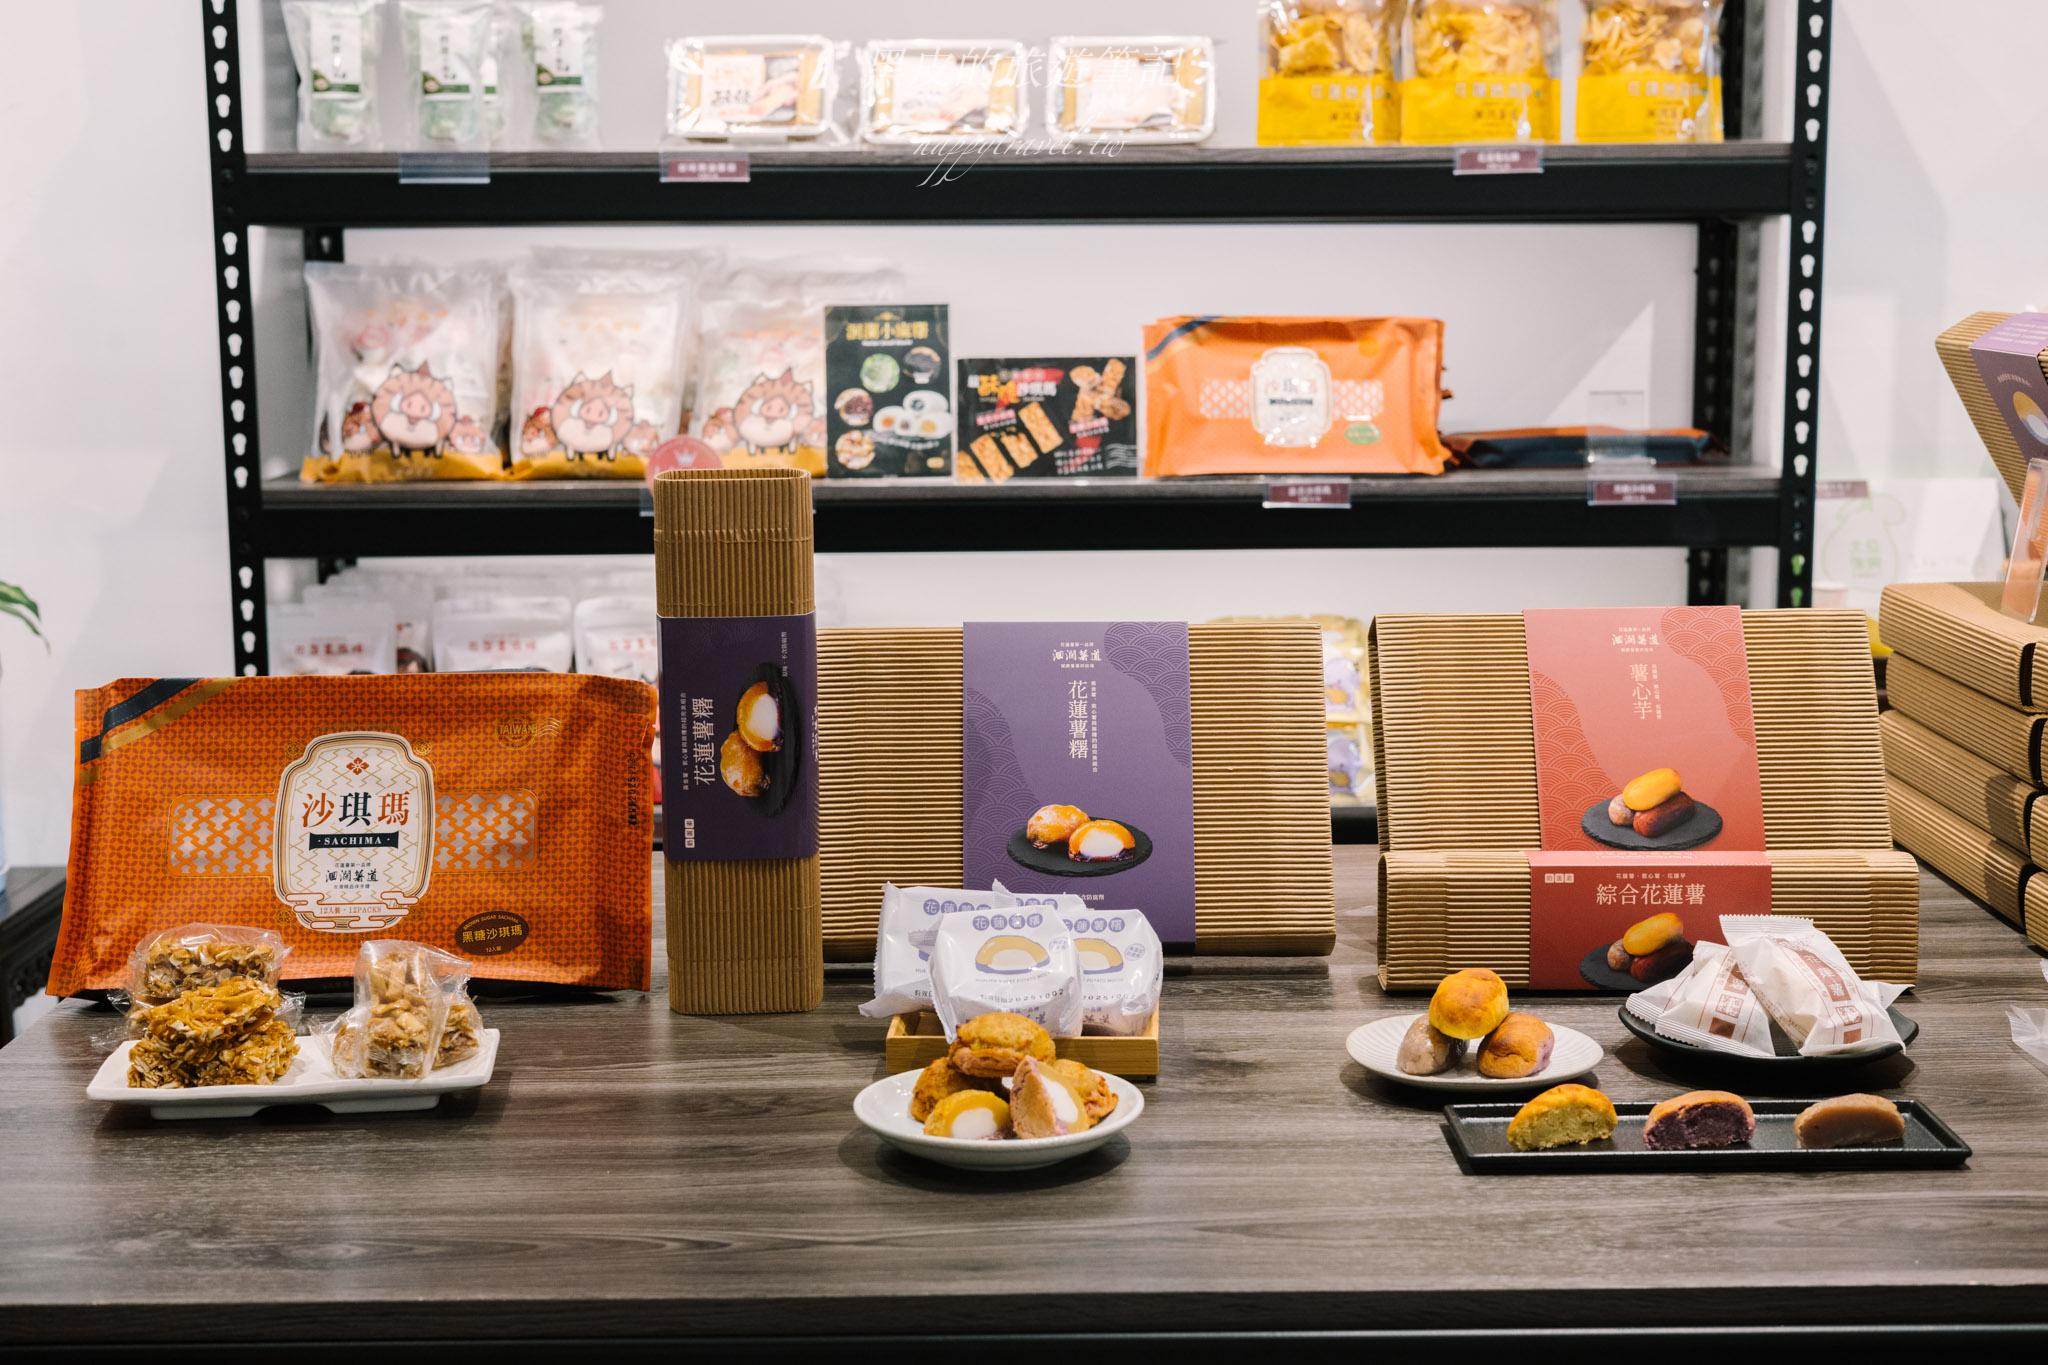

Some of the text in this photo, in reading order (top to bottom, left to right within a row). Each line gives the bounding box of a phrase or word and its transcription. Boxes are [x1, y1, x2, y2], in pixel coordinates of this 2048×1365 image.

[1630, 662, 1654, 720] 薯心芋
[498, 724, 537, 735] TAIWAN
[1067, 679, 1089, 759] 花蓮薯糬
[692, 697, 716, 786] 花蓮薯糬
[302, 791, 411, 828] 沙琪瑪
[323, 836, 383, 845] SACHIMA
[1596, 883, 1706, 906] 綜合花蓮薯
[462, 924, 523, 943] 黑糖沙琪瑪
